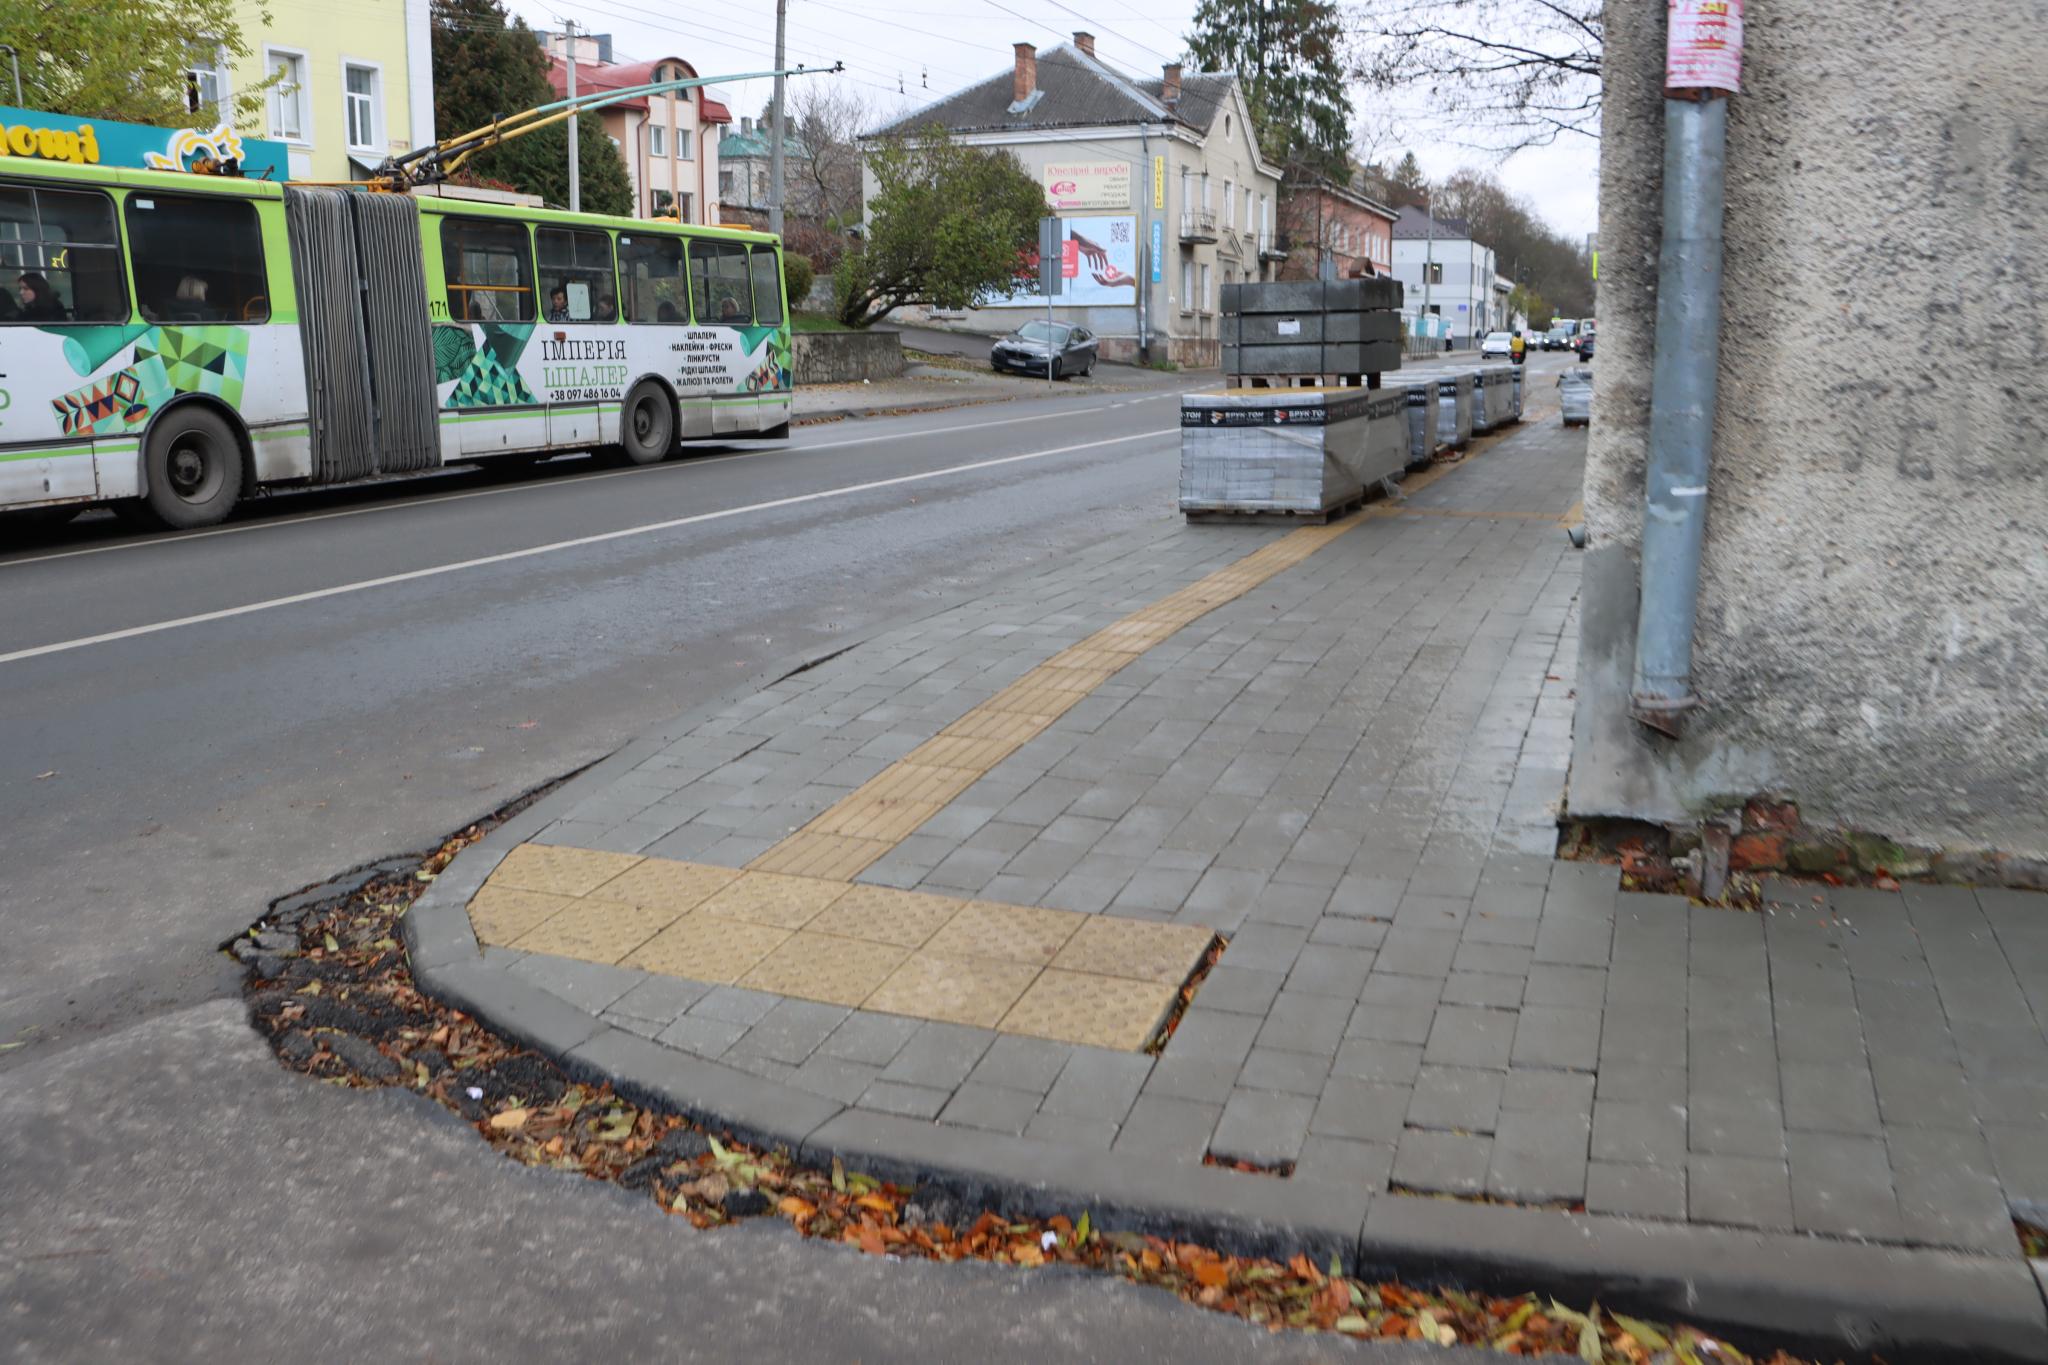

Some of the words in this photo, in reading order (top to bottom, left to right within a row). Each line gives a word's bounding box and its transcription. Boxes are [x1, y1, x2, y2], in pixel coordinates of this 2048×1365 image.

[430, 301, 447, 317] 171
[687, 331, 717, 340] ШПАЛЕРИ
[541, 340, 628, 361] ІМПЕРІЯ
[672, 341, 705, 352] НАКЛЕЙКИ
[709, 343, 733, 351] ФРЕСКИ
[687, 354, 720, 363] ЛІНКРУСТИ
[681, 366, 697, 376] РІДКІ
[698, 365, 727, 375] ШПАЛЕРИ
[543, 365, 628, 388] ШПАЛЕР
[676, 377, 702, 387] ЖАЛЮЗІ
[703, 377, 710, 385] ТА
[711, 376, 734, 385] РОЛЕТИ
[550, 390, 565, 401] +38
[566, 389, 582, 400] 097
[583, 388, 599, 399] 486
[599, 388, 609, 398] 16
[610, 388, 621, 398] 04
